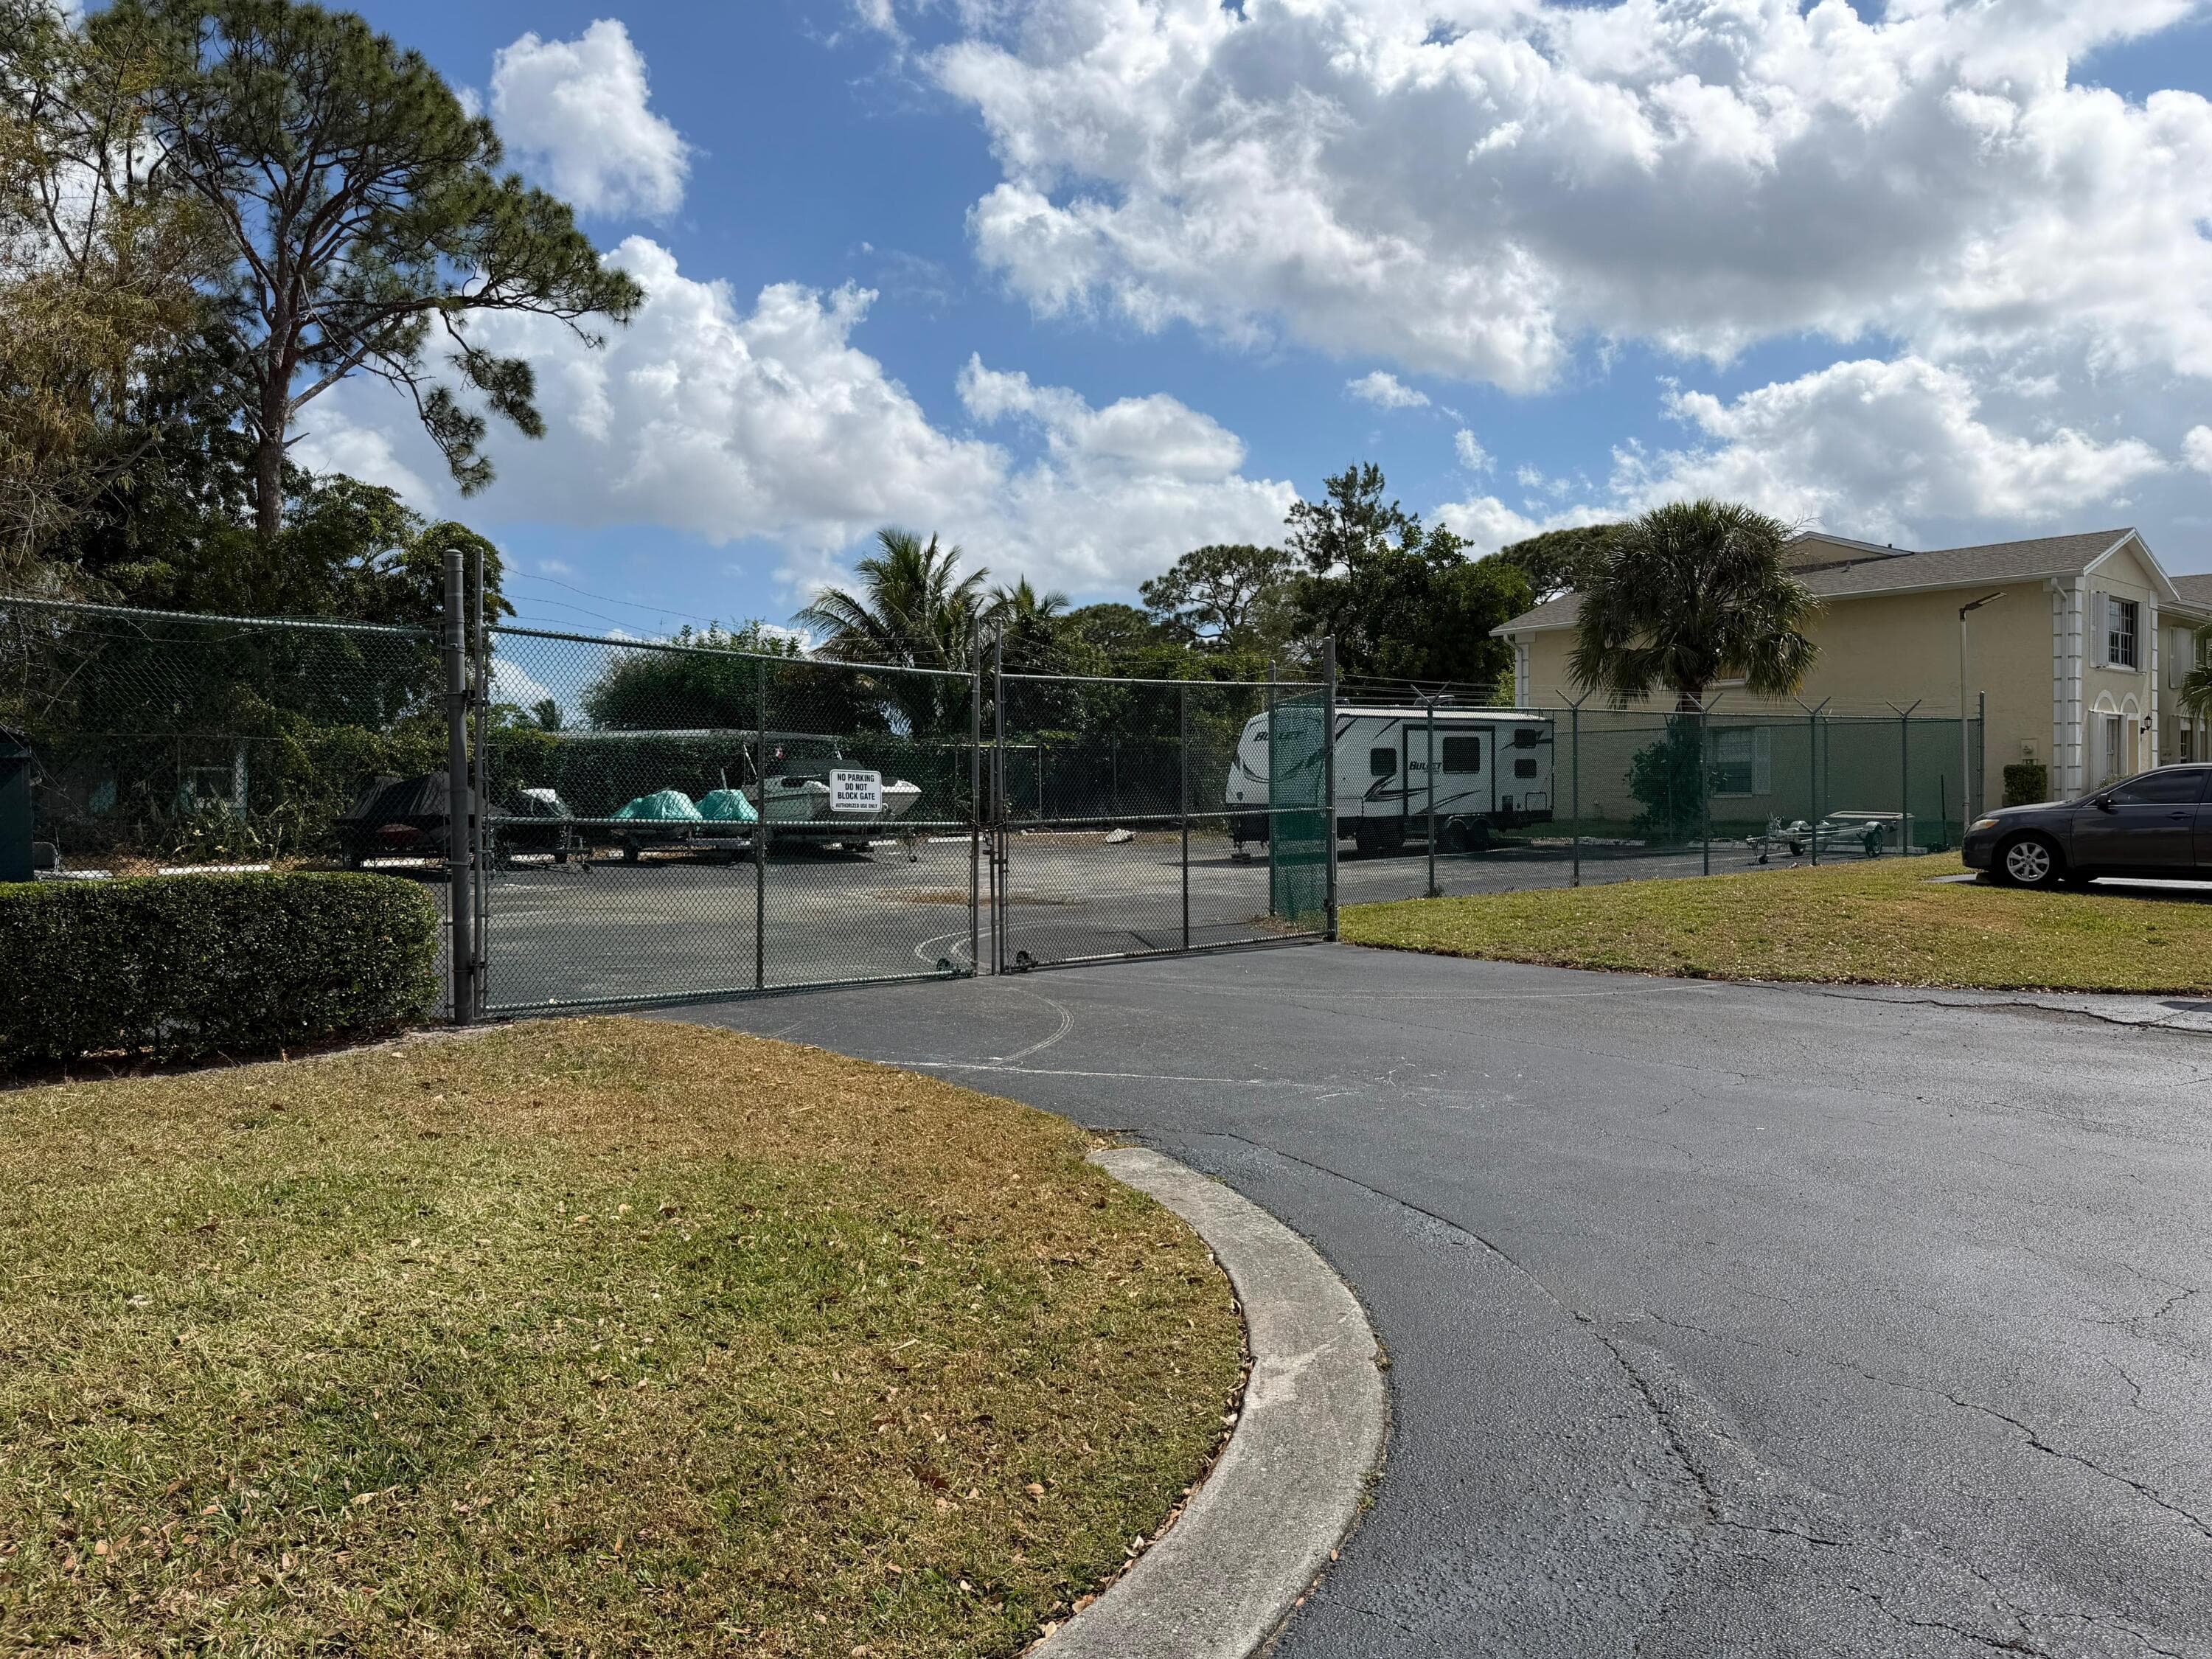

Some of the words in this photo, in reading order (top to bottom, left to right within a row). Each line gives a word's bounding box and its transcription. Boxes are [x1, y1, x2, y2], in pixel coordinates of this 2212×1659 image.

[1253, 731, 1304, 742] BULET
[848, 773, 874, 782] PARKING
[855, 783, 867, 791] NOT
[838, 792, 858, 800] BLOCK
